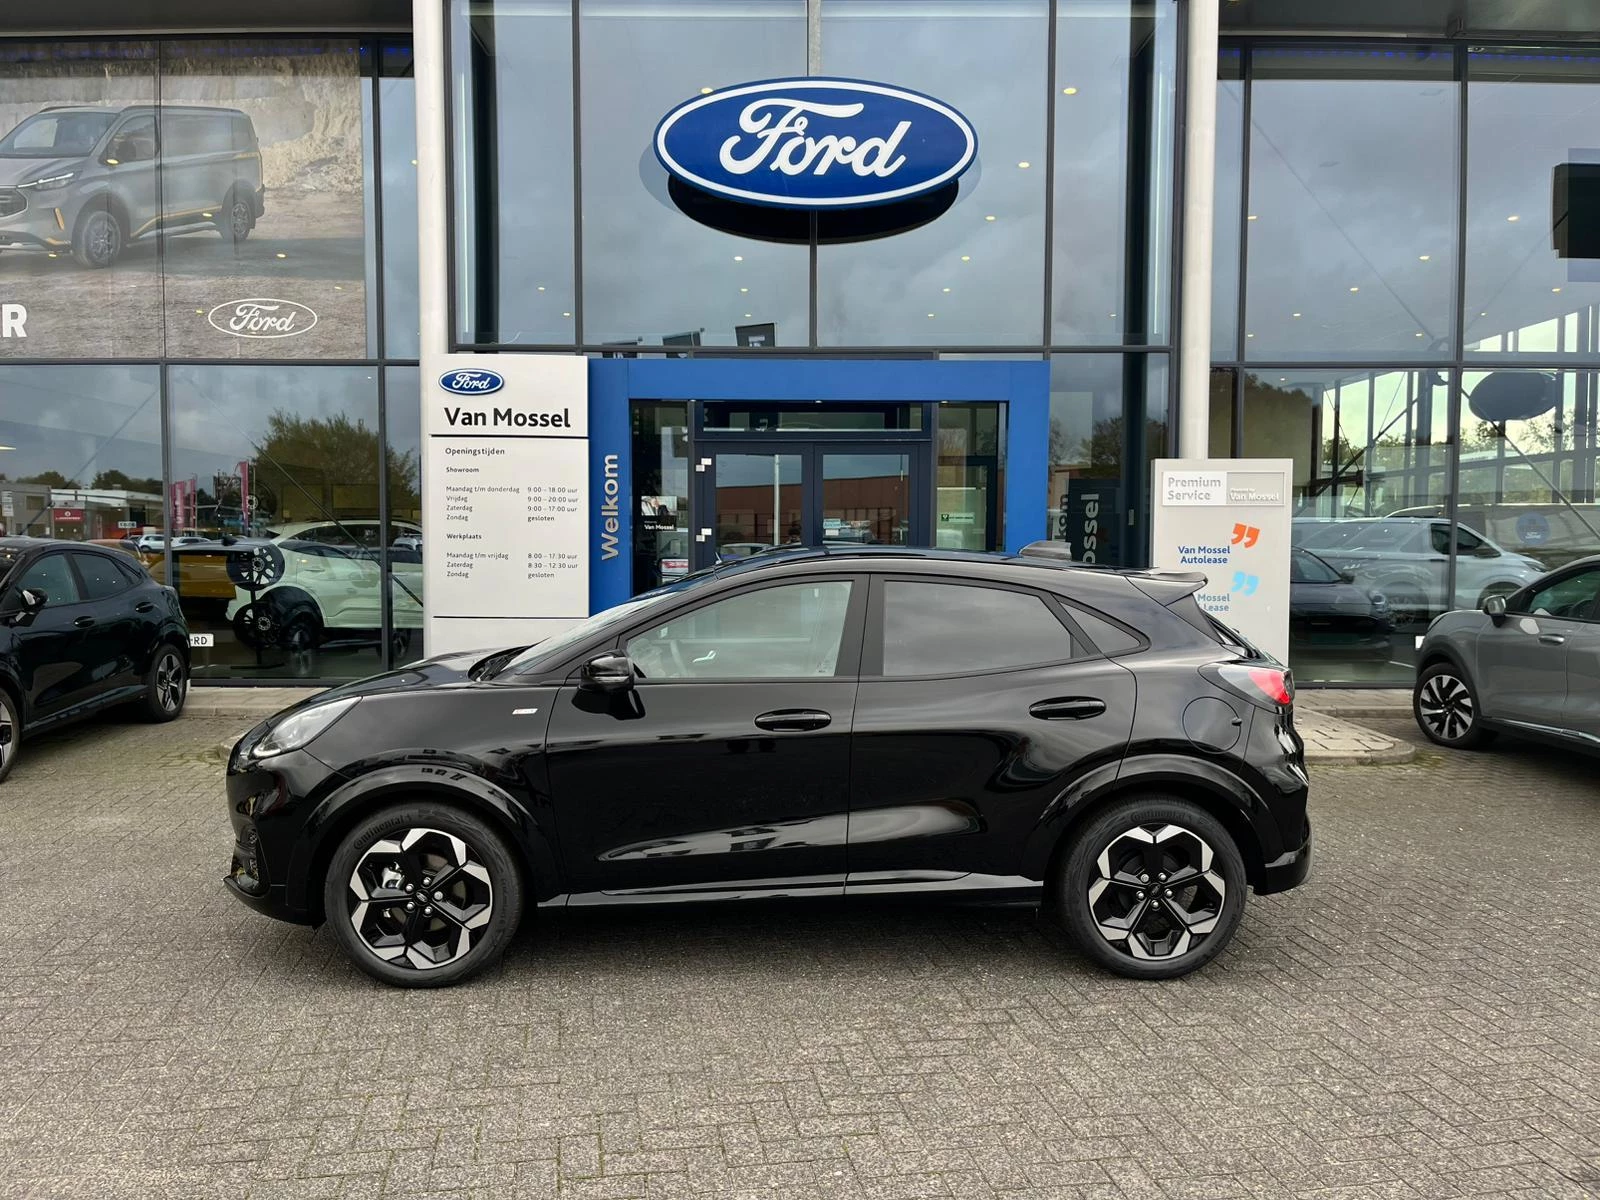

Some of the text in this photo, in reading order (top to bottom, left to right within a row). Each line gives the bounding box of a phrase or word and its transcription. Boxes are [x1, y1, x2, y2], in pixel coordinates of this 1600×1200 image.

[719, 98, 912, 177] Ford
[0, 304, 27, 337] R
[230, 304, 296, 331] Ford
[452, 373, 491, 389] Ford
[444, 407, 571, 428] Van Mossel
[445, 448, 505, 456] Openingstijden
[1168, 477, 1221, 487] Premium
[487, 486, 520, 494] donderdag
[1168, 490, 1211, 500] Service
[1230, 491, 1280, 501] Van Mossel
[601, 454, 619, 560] Welkom
[1055, 494, 1068, 540] kom
[1081, 494, 1099, 563] ossel
[1178, 545, 1230, 554] Van Mossel
[446, 552, 474, 560] Maandag
[487, 552, 509, 560] vrijdag
[1180, 556, 1228, 564] Autolease
[446, 561, 473, 569] Zaterdag
[1204, 603, 1230, 611] Lease
[190, 637, 207, 645] -RD
[353, 815, 405, 849] Continental
